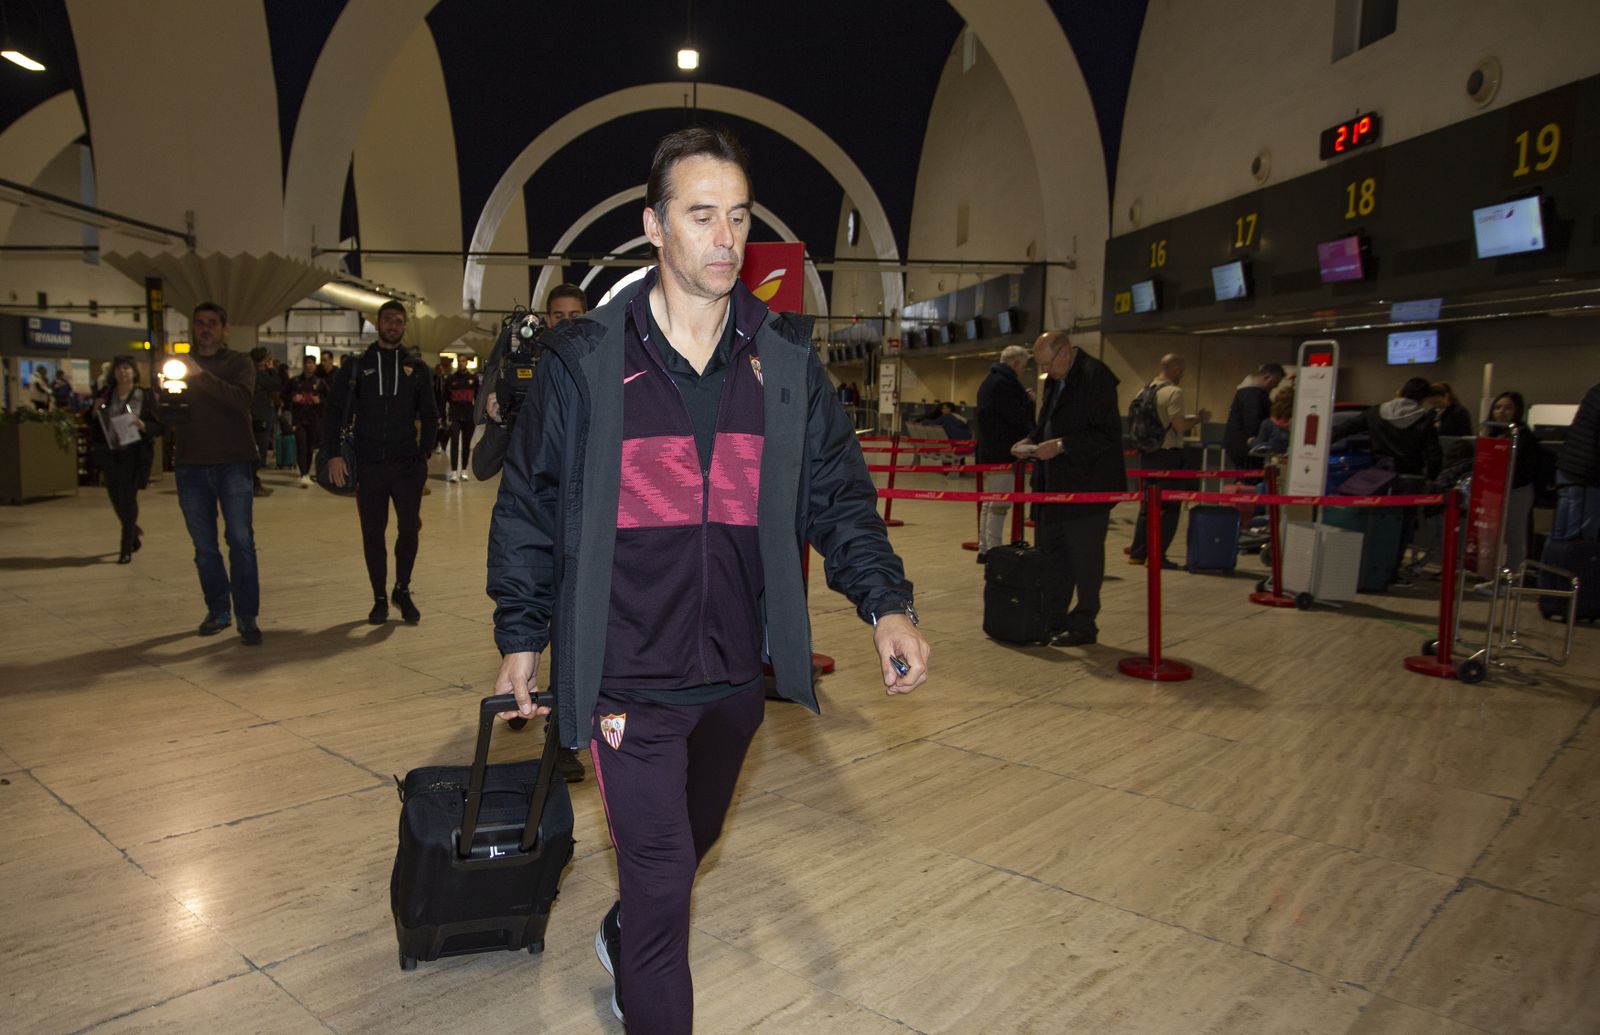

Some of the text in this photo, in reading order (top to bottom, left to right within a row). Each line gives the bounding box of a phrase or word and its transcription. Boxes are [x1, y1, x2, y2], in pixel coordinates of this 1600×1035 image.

[1511, 122, 1561, 178] 19
[1344, 177, 1377, 220] 18
[1234, 213, 1258, 249] 17
[1150, 239, 1168, 269] 16
[34, 332, 72, 346] RYANAIR
